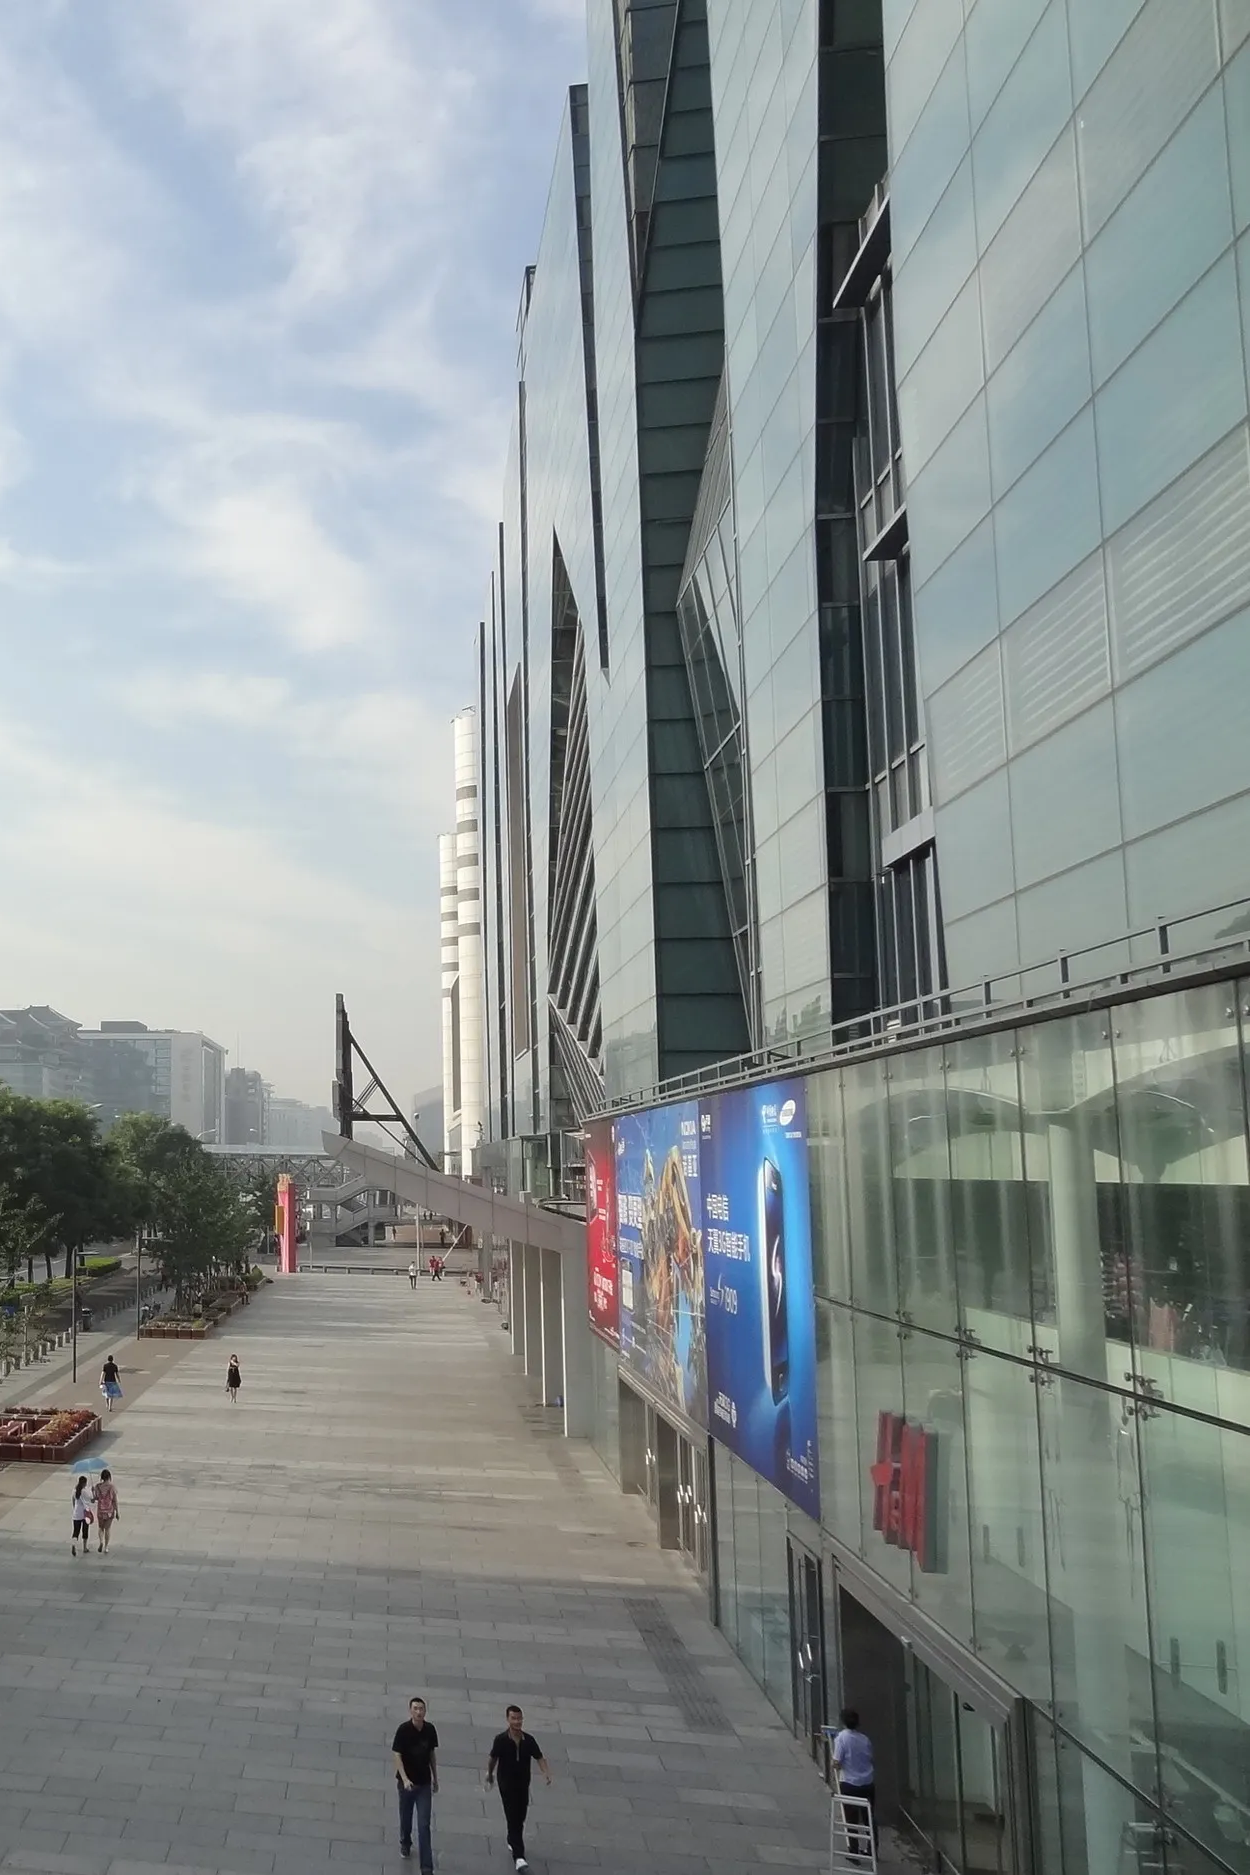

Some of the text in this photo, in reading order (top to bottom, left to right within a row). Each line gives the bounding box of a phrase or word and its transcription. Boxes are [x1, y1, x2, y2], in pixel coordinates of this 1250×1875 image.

[706, 1193, 729, 1222] 中国电信
[707, 1228, 751, 1262] 天翼3G智能手机
